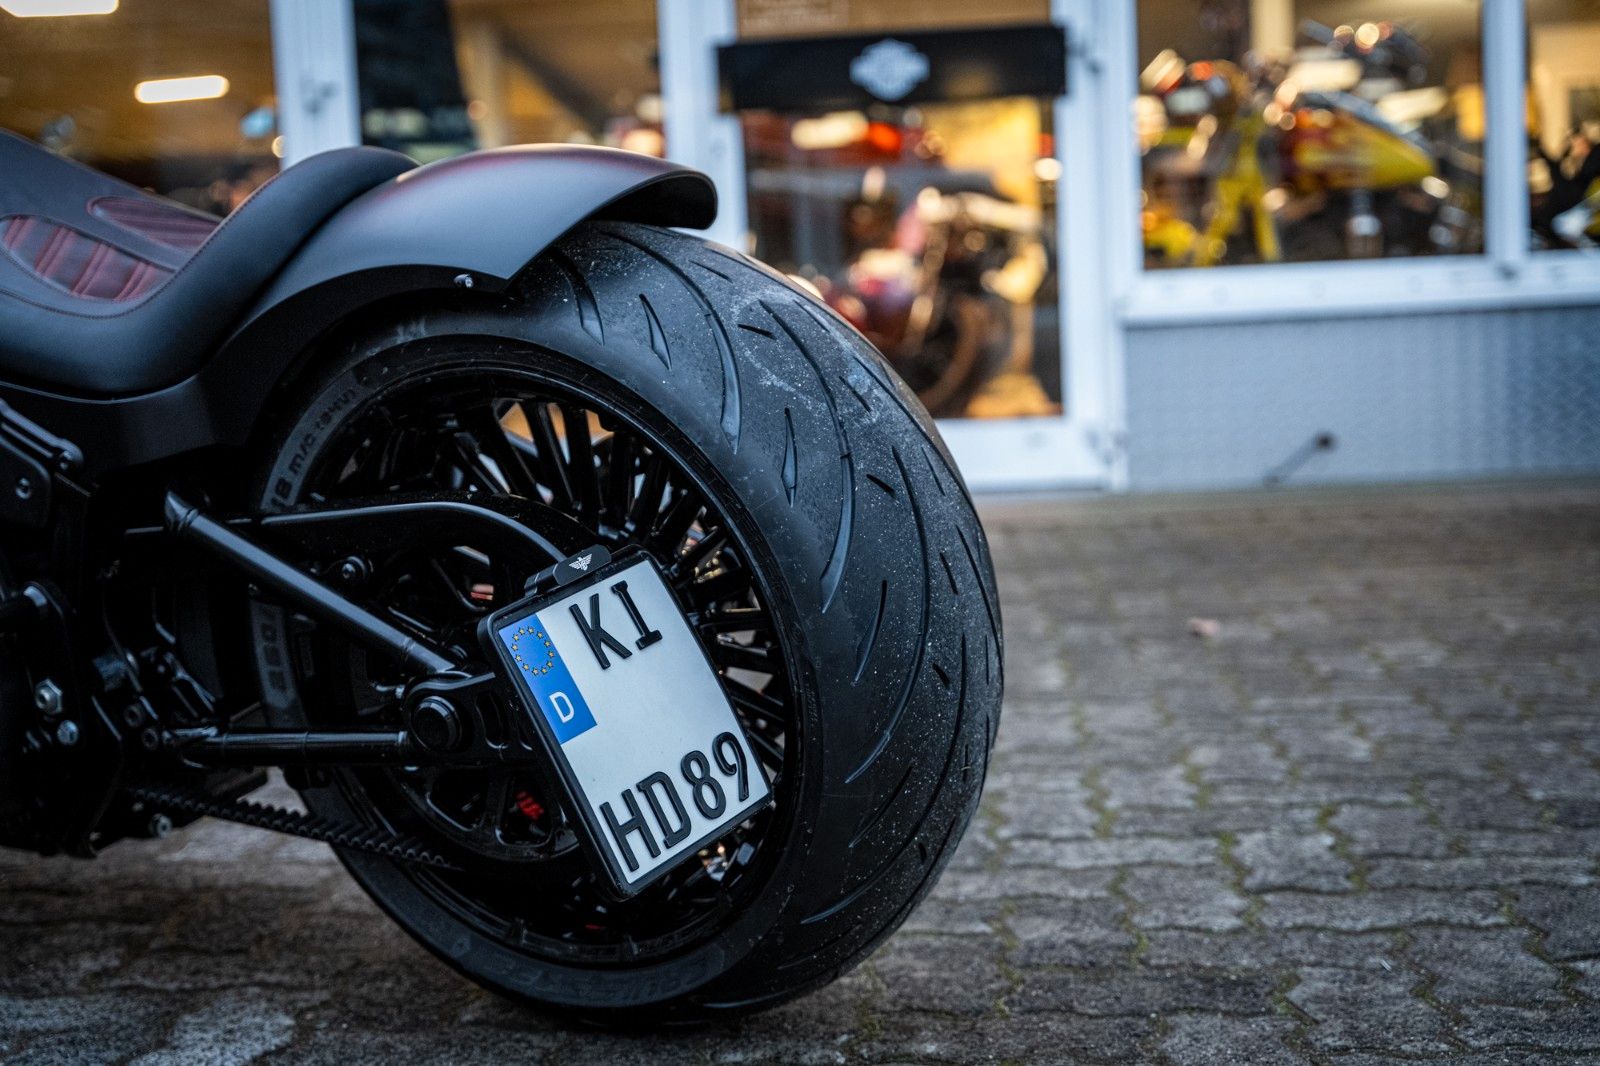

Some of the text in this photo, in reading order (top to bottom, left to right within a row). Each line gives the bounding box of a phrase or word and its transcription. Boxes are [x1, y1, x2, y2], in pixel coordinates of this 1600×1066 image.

[568, 580, 663, 670] KI
[549, 691, 575, 723] D
[599, 731, 750, 872] HD89
